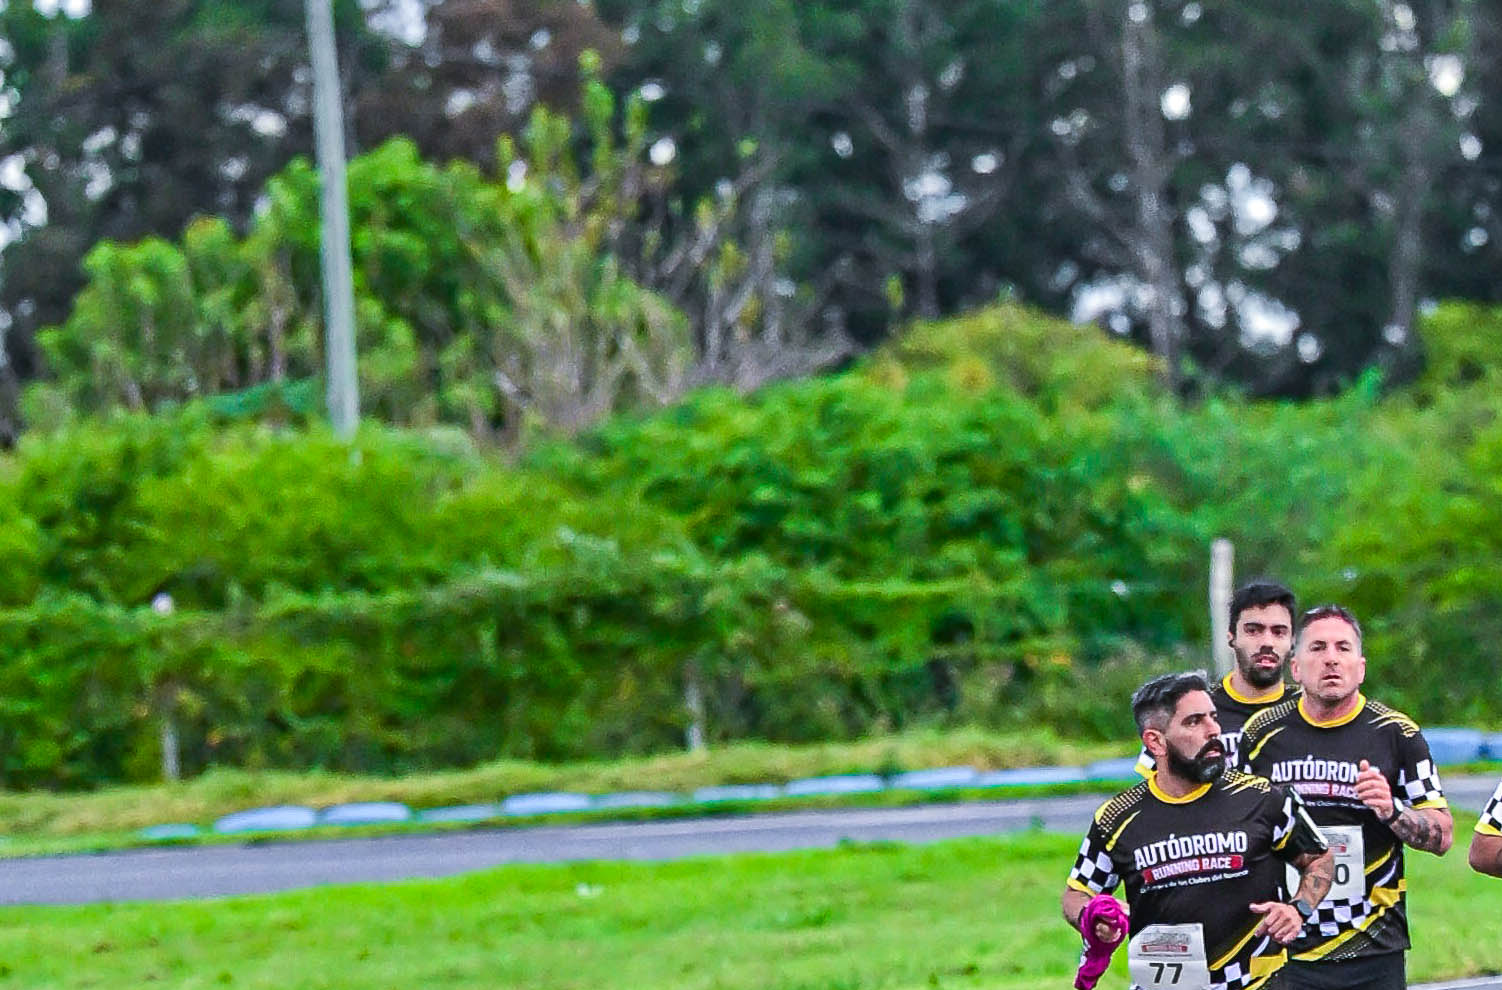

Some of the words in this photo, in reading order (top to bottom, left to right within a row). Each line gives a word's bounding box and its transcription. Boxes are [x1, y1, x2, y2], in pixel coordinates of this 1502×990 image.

[1270, 754, 1360, 784] AUTÓDRO
[1133, 831, 1248, 871] AUTÓDROMO
[1151, 860, 1200, 881] RUNNING
[1201, 855, 1232, 870] RACE
[1149, 962, 1183, 985] 77
